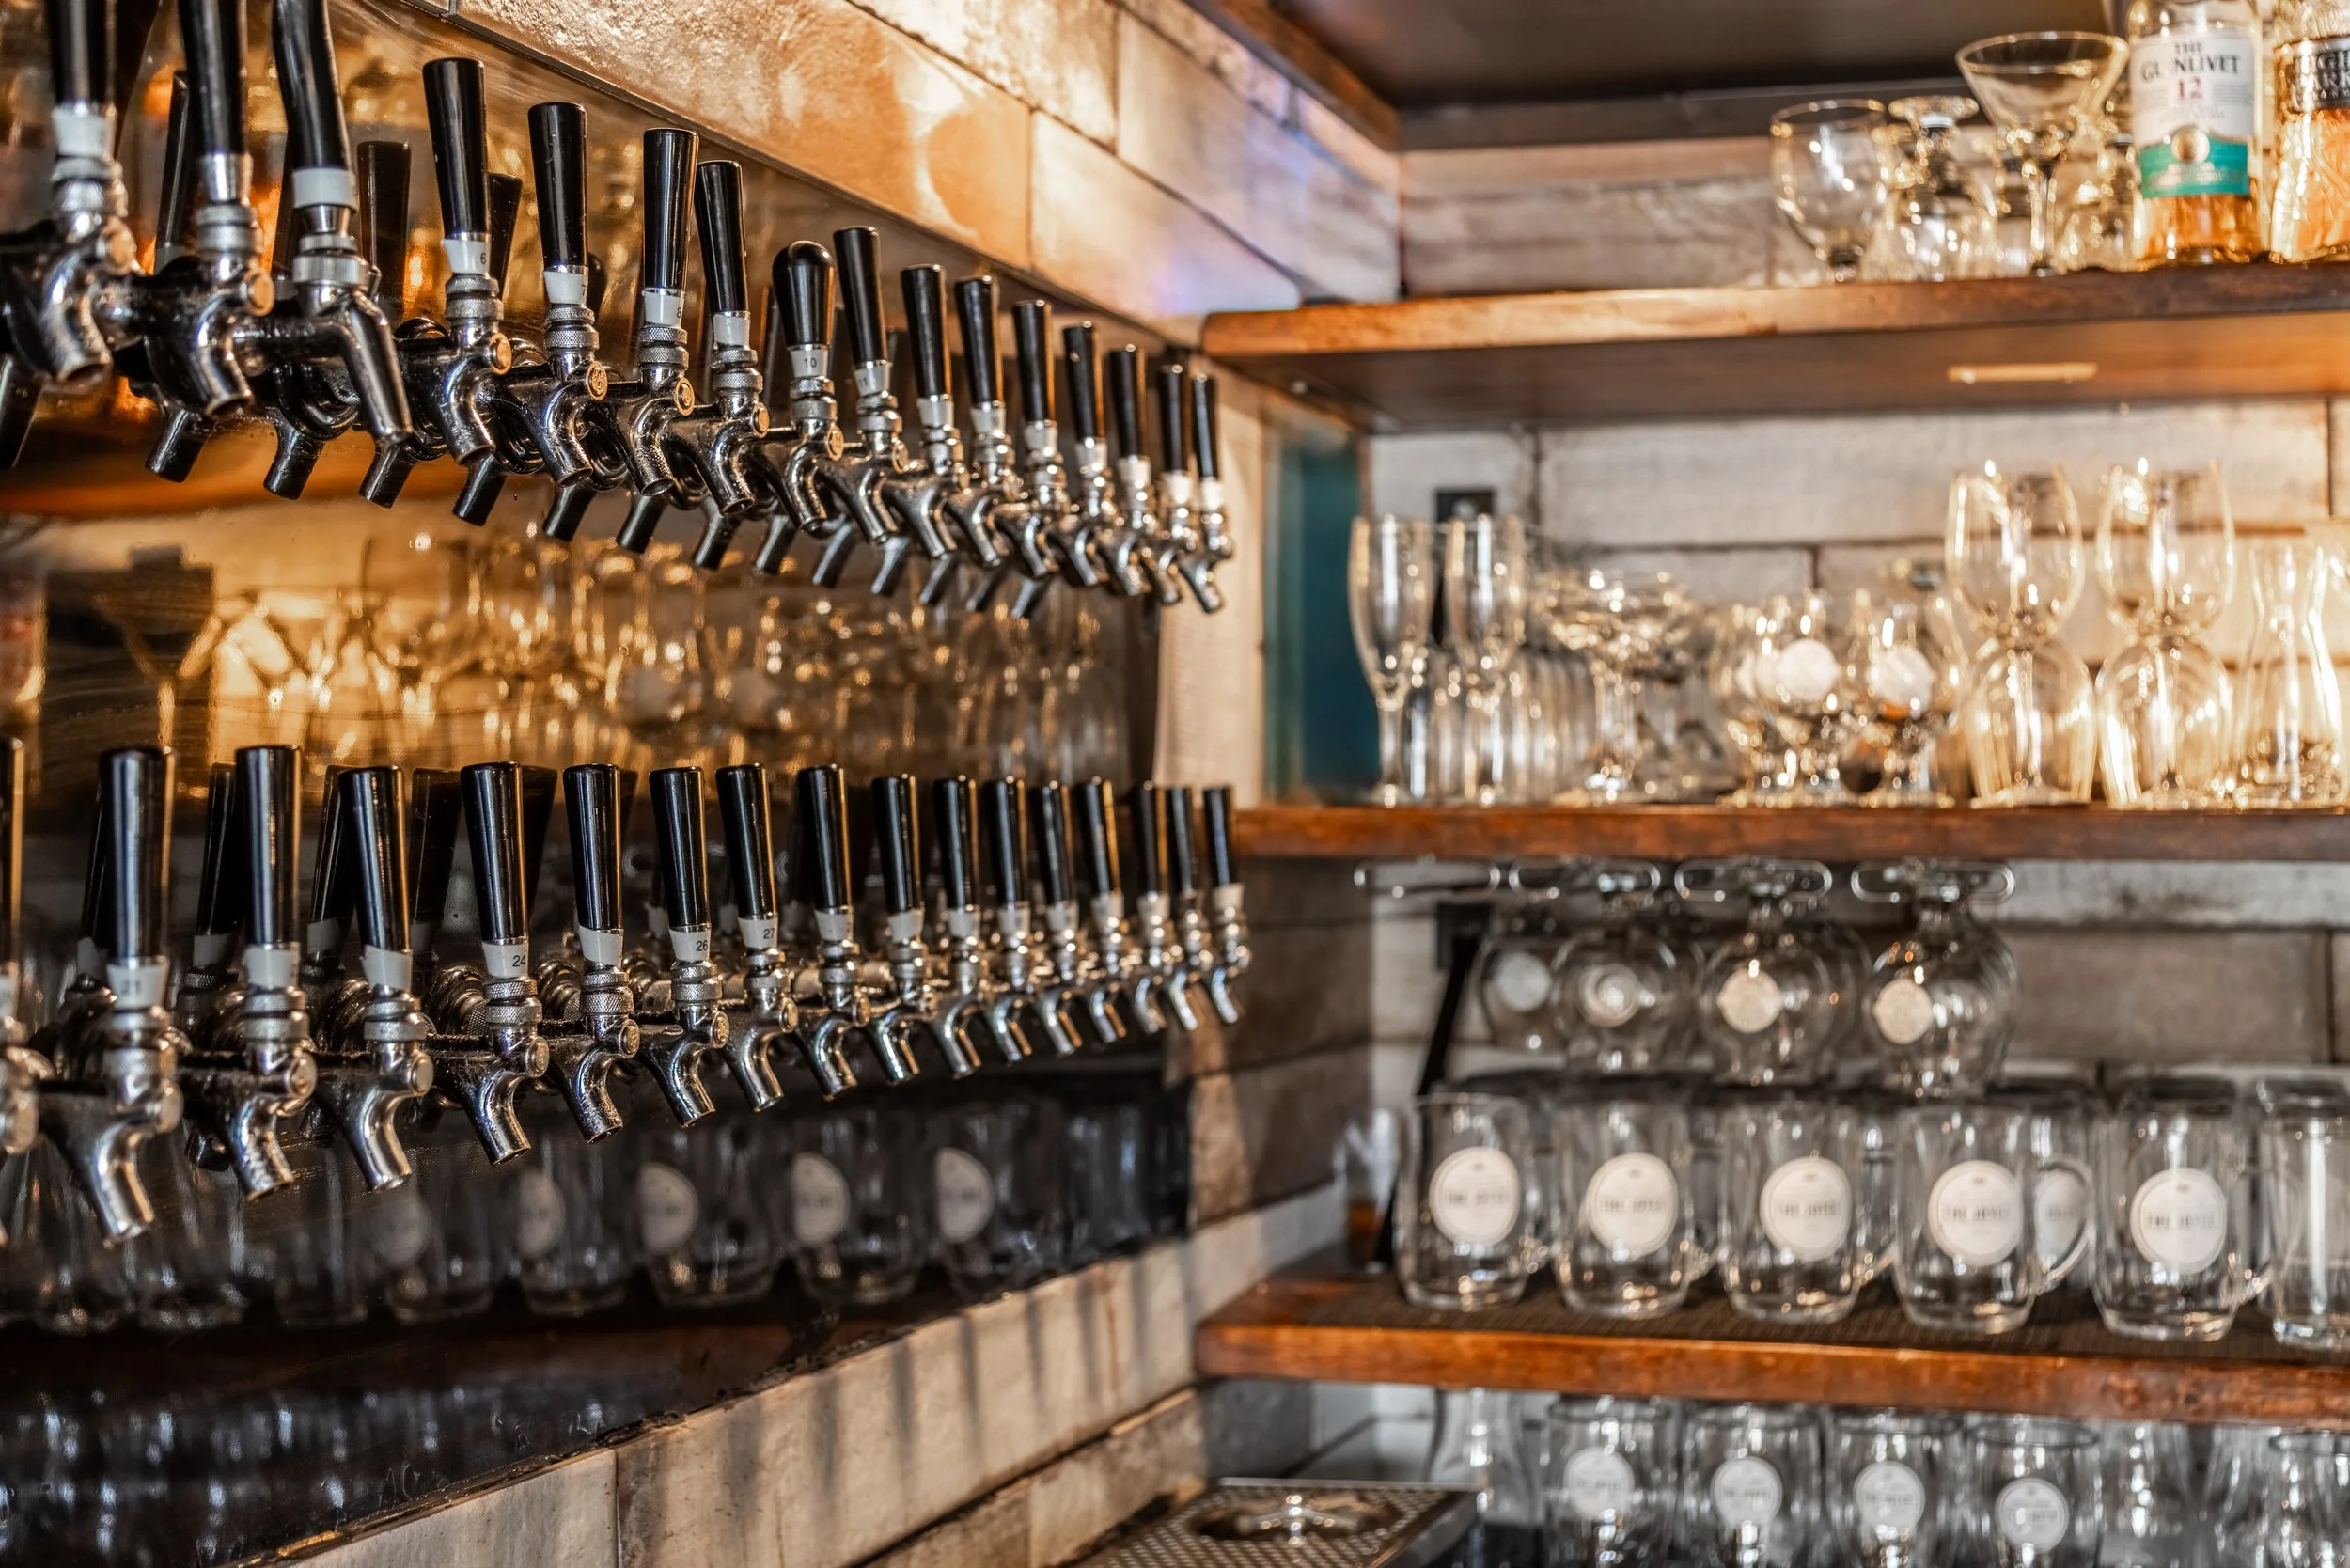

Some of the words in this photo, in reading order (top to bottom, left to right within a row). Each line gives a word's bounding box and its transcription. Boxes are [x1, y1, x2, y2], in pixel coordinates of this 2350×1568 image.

[2141, 54, 2241, 81] GLNLIVET
[2177, 78, 2203, 102] 12
[480, 252, 487, 265] 6
[804, 357, 817, 368] 10
[762, 928, 776, 940] 27
[696, 940, 708, 951] 26
[512, 954, 526, 968] 24
